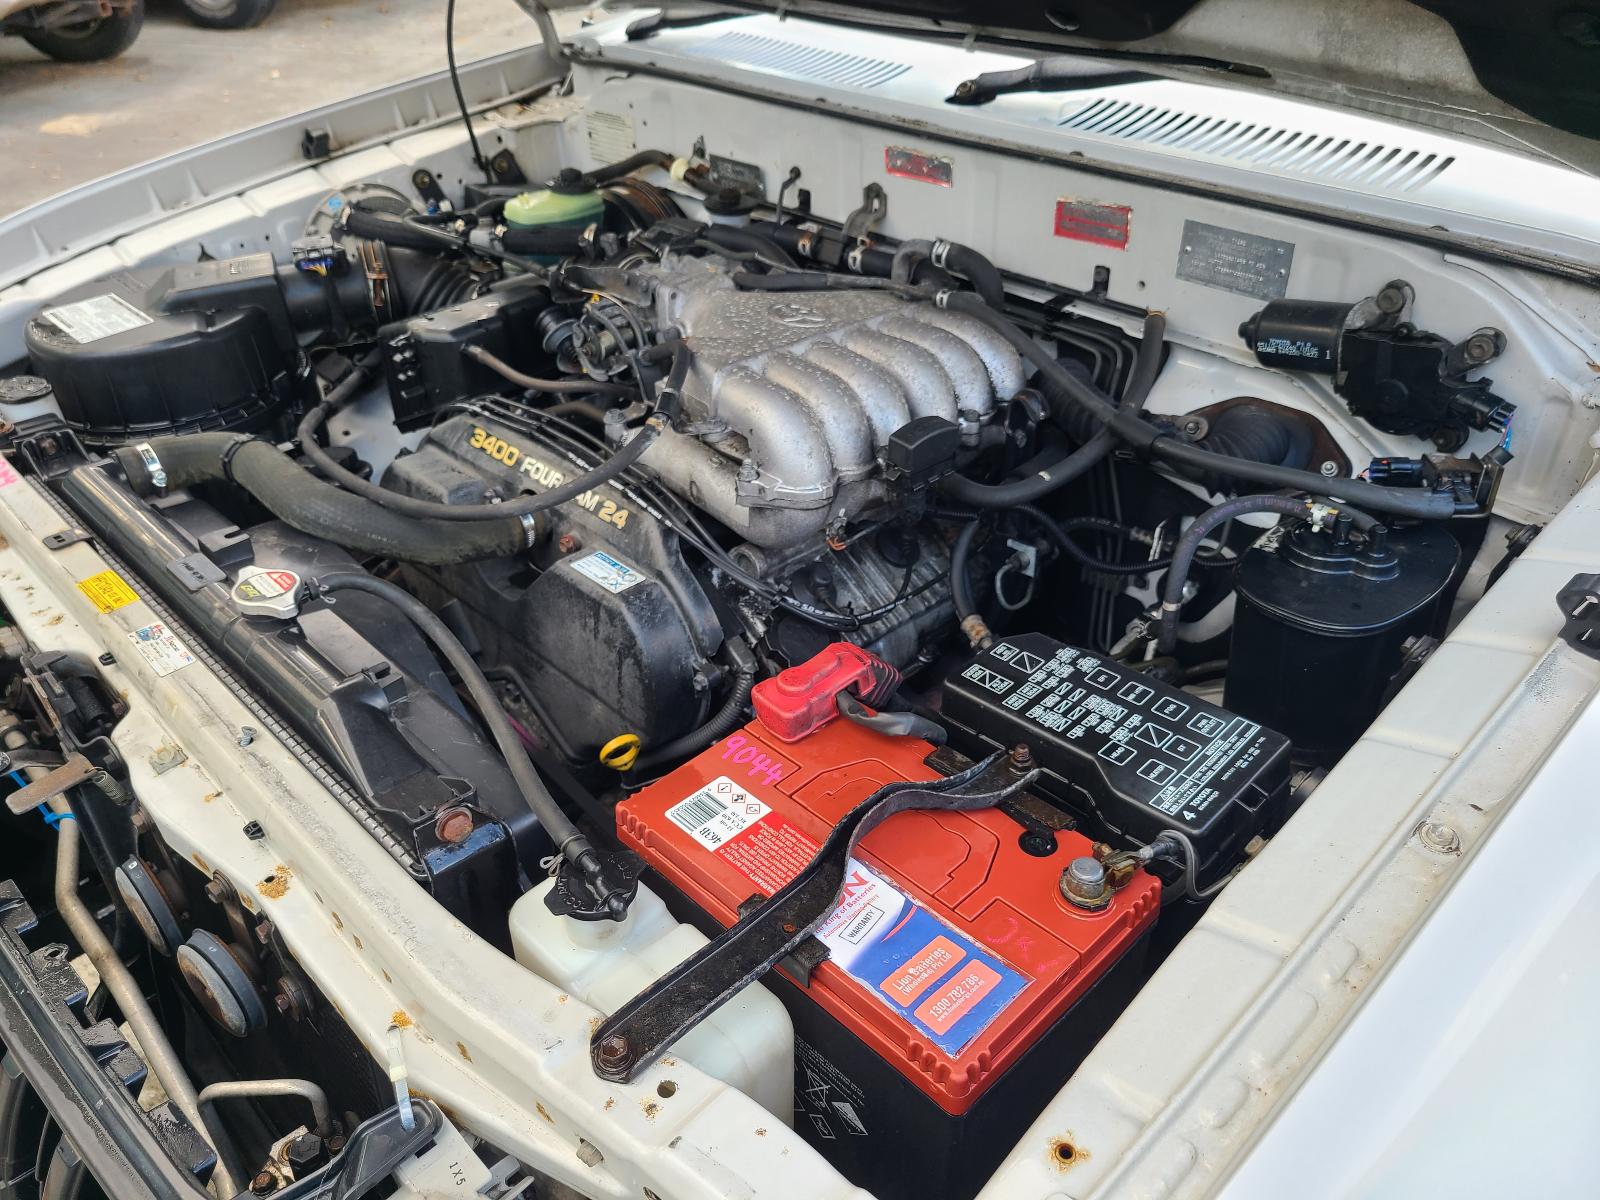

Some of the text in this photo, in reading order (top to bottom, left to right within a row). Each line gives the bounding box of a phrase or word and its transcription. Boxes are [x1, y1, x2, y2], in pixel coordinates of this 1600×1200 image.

[470, 428, 520, 467] 3400
[520, 456, 564, 488] FOUR
[576, 490, 600, 512] AM
[599, 500, 628, 530] 24
[722, 736, 783, 786] 9044
[1111, 747, 1124, 758] HEAD
[1205, 739, 1224, 756] NOTICE
[1190, 788, 1212, 806] TOYOTA
[1182, 809, 1197, 820] 4
[700, 827, 722, 844] 463B
[824, 912, 842, 926] King
[847, 884, 876, 908] Batteries
[848, 910, 875, 938] WARRANTY
[892, 948, 946, 990] Lion Batteries
[930, 974, 980, 1017] 1300 782 786
